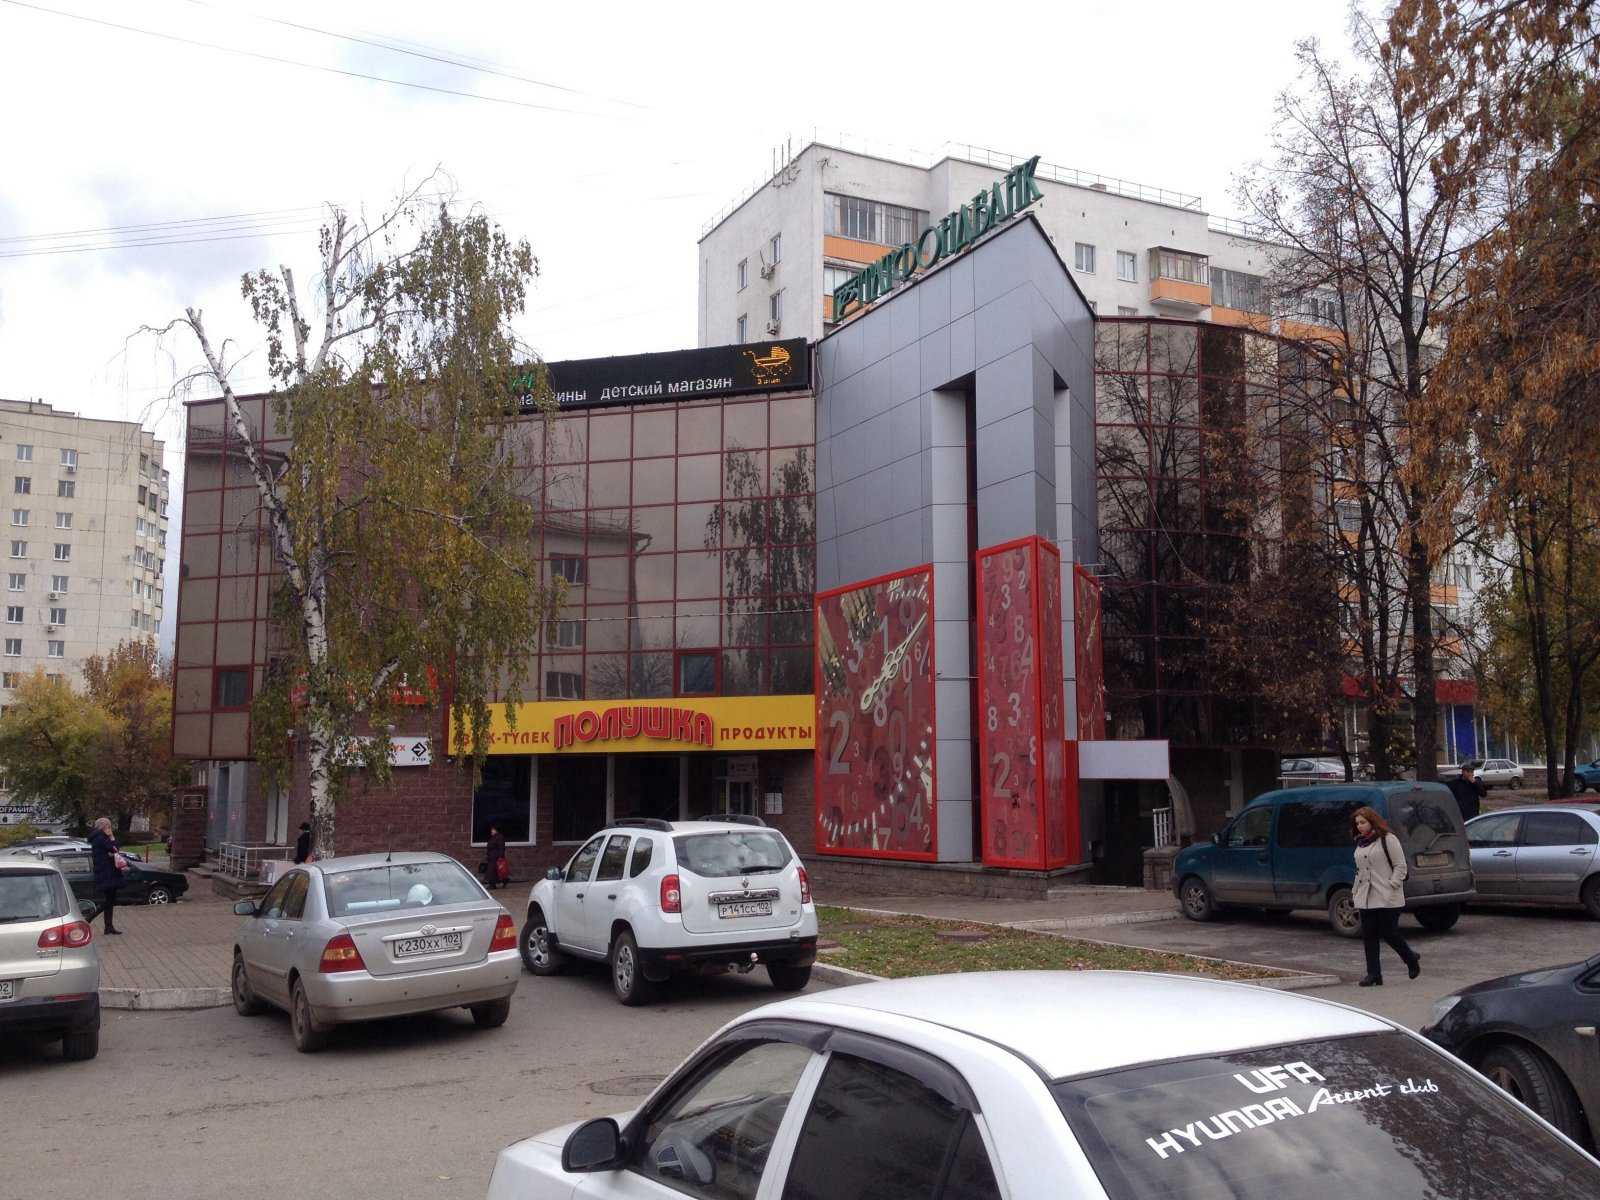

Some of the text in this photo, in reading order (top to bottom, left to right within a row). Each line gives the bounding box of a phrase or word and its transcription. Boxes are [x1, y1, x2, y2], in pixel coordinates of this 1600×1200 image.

[600, 381, 662, 400] детский
[668, 377, 732, 393] магазин
[1001, 583, 1012, 609] 3
[1014, 614, 1025, 643] 8
[987, 706, 998, 732] 8
[1008, 692, 1022, 726] 3
[553, 706, 714, 748] ПОЛУШКА
[720, 726, 812, 741] ПРОДУКТЫ
[828, 711, 851, 775] 2
[991, 751, 1012, 798] 2
[443, 934, 459, 945] 102
[1233, 1061, 1326, 1094] UFA
[1145, 1078, 1439, 1159] HYUNDAI Accent club
